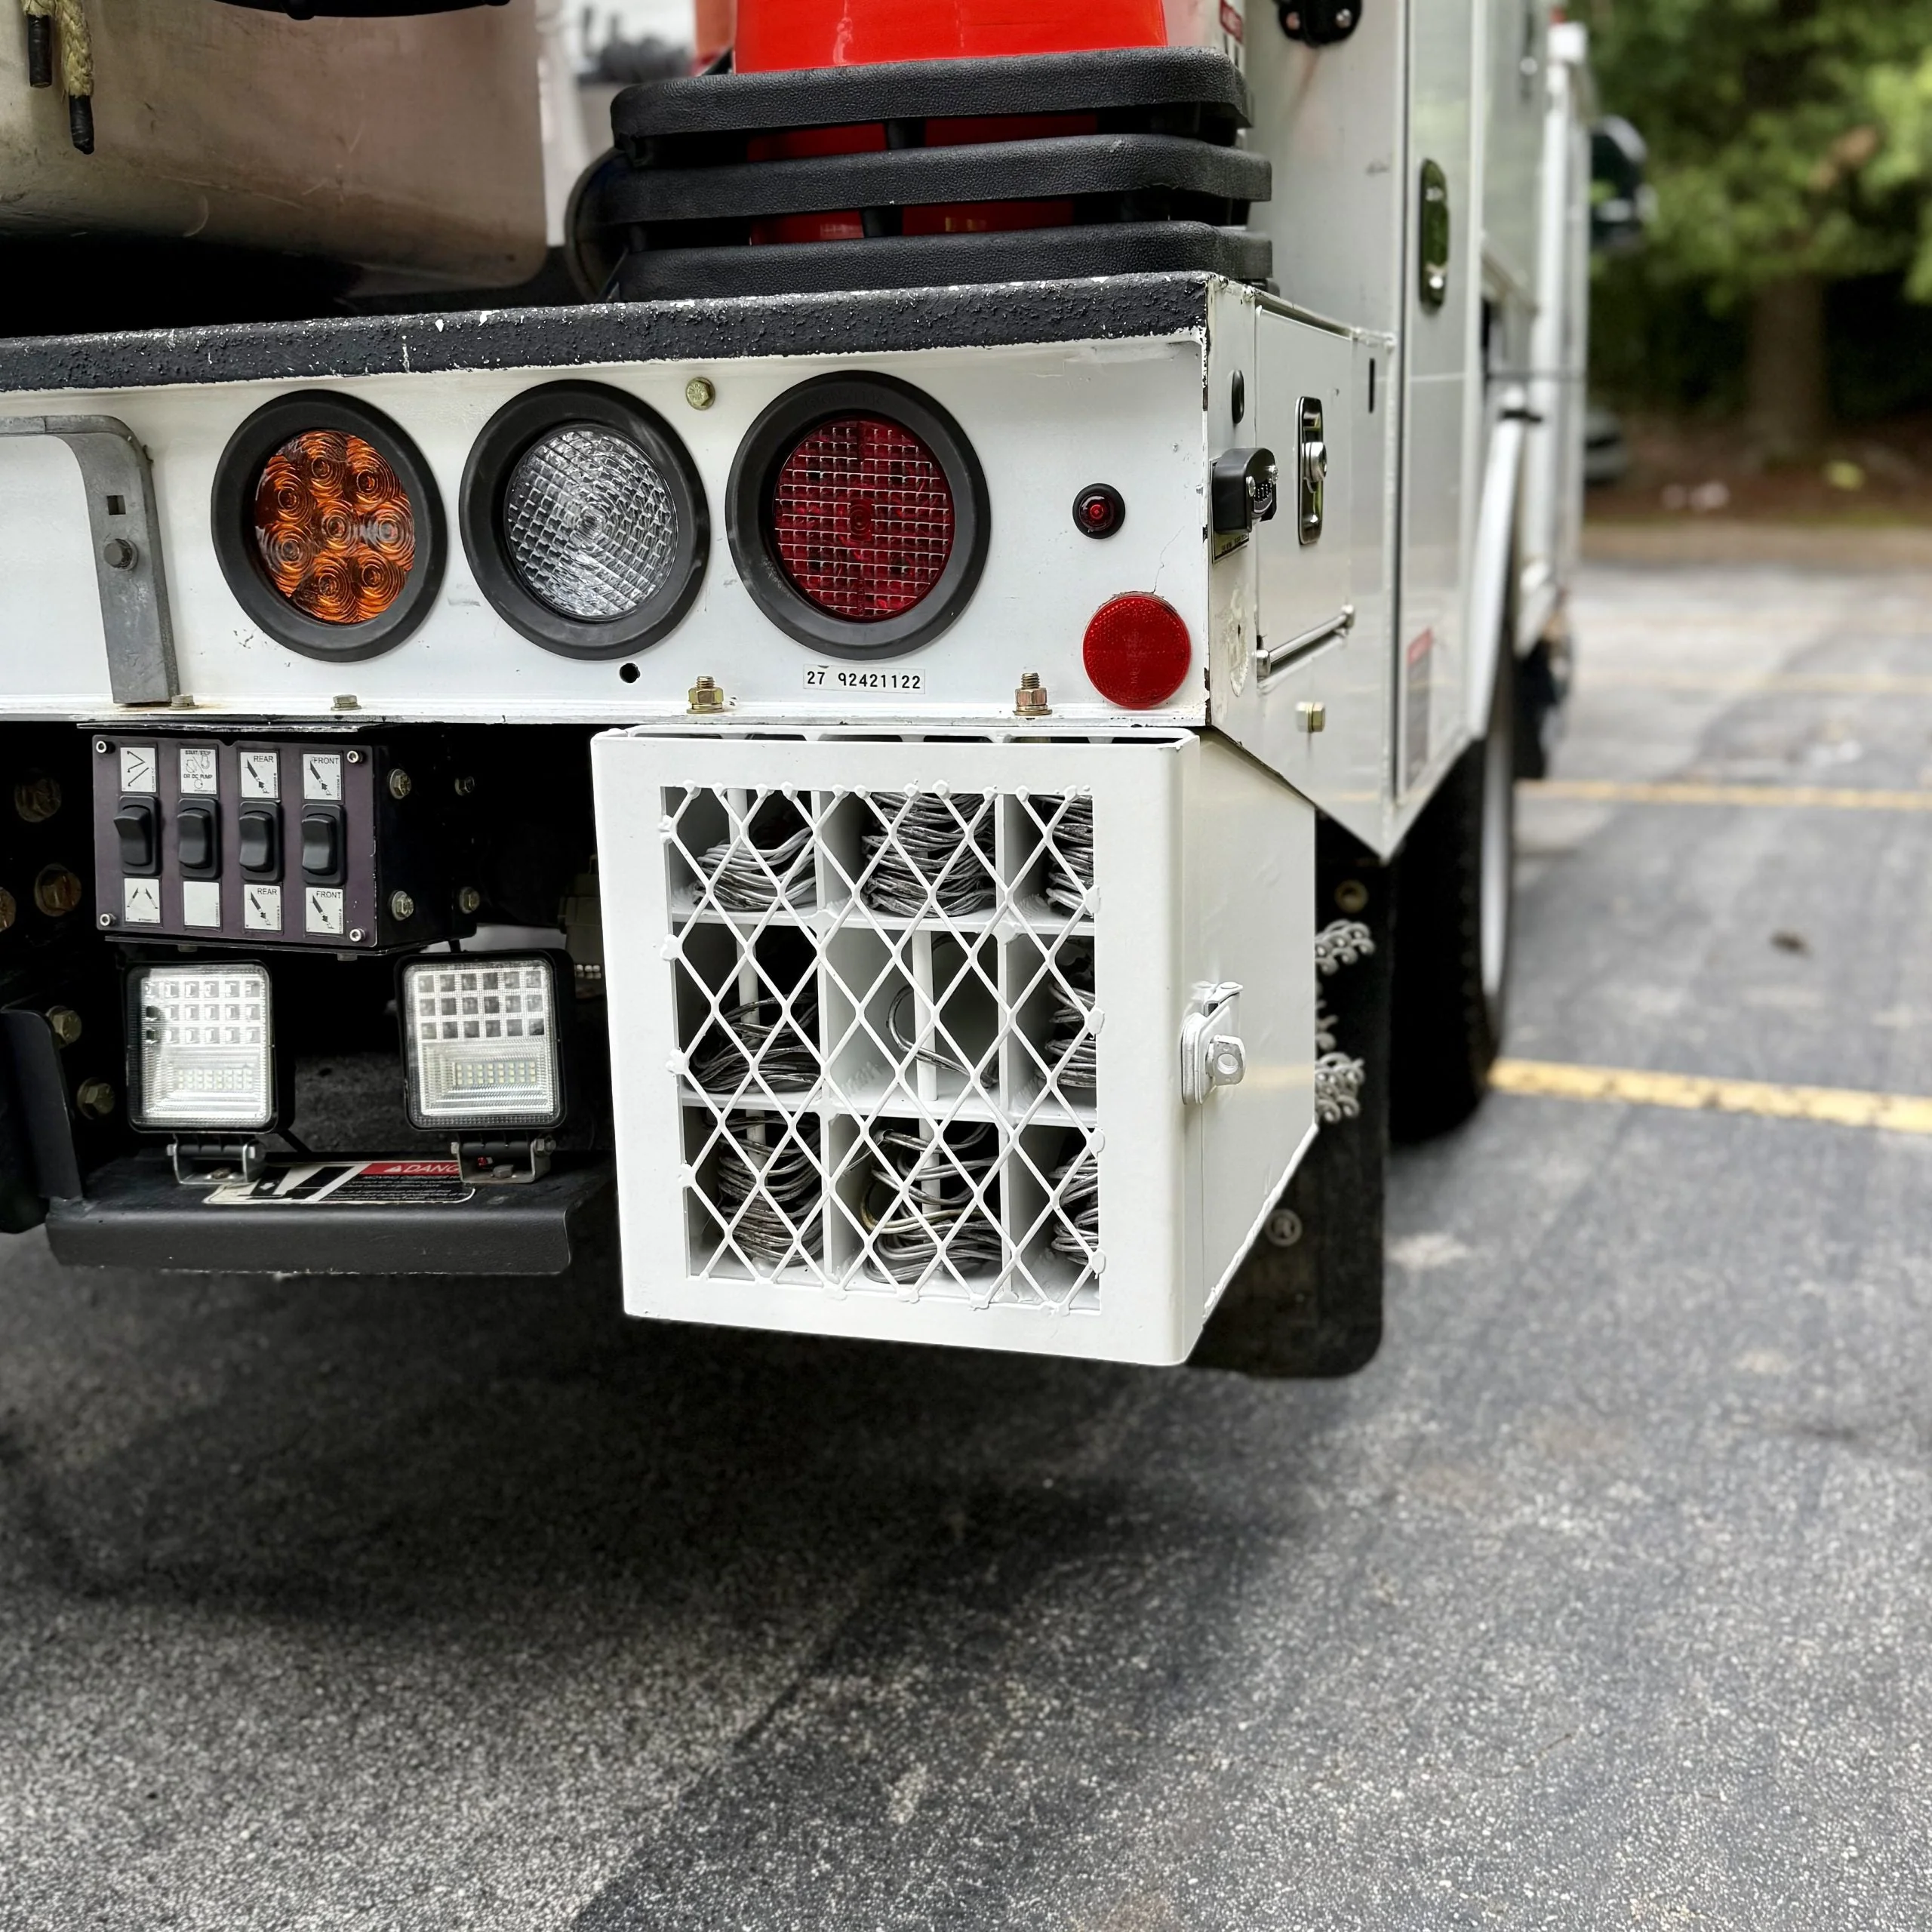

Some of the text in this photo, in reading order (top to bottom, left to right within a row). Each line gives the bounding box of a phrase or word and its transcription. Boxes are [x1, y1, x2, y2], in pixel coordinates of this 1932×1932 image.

[807, 671, 921, 689] 27 92421122
[257, 888, 278, 896] REAR
[316, 891, 342, 899] FRONT
[403, 1164, 460, 1174] DANG
